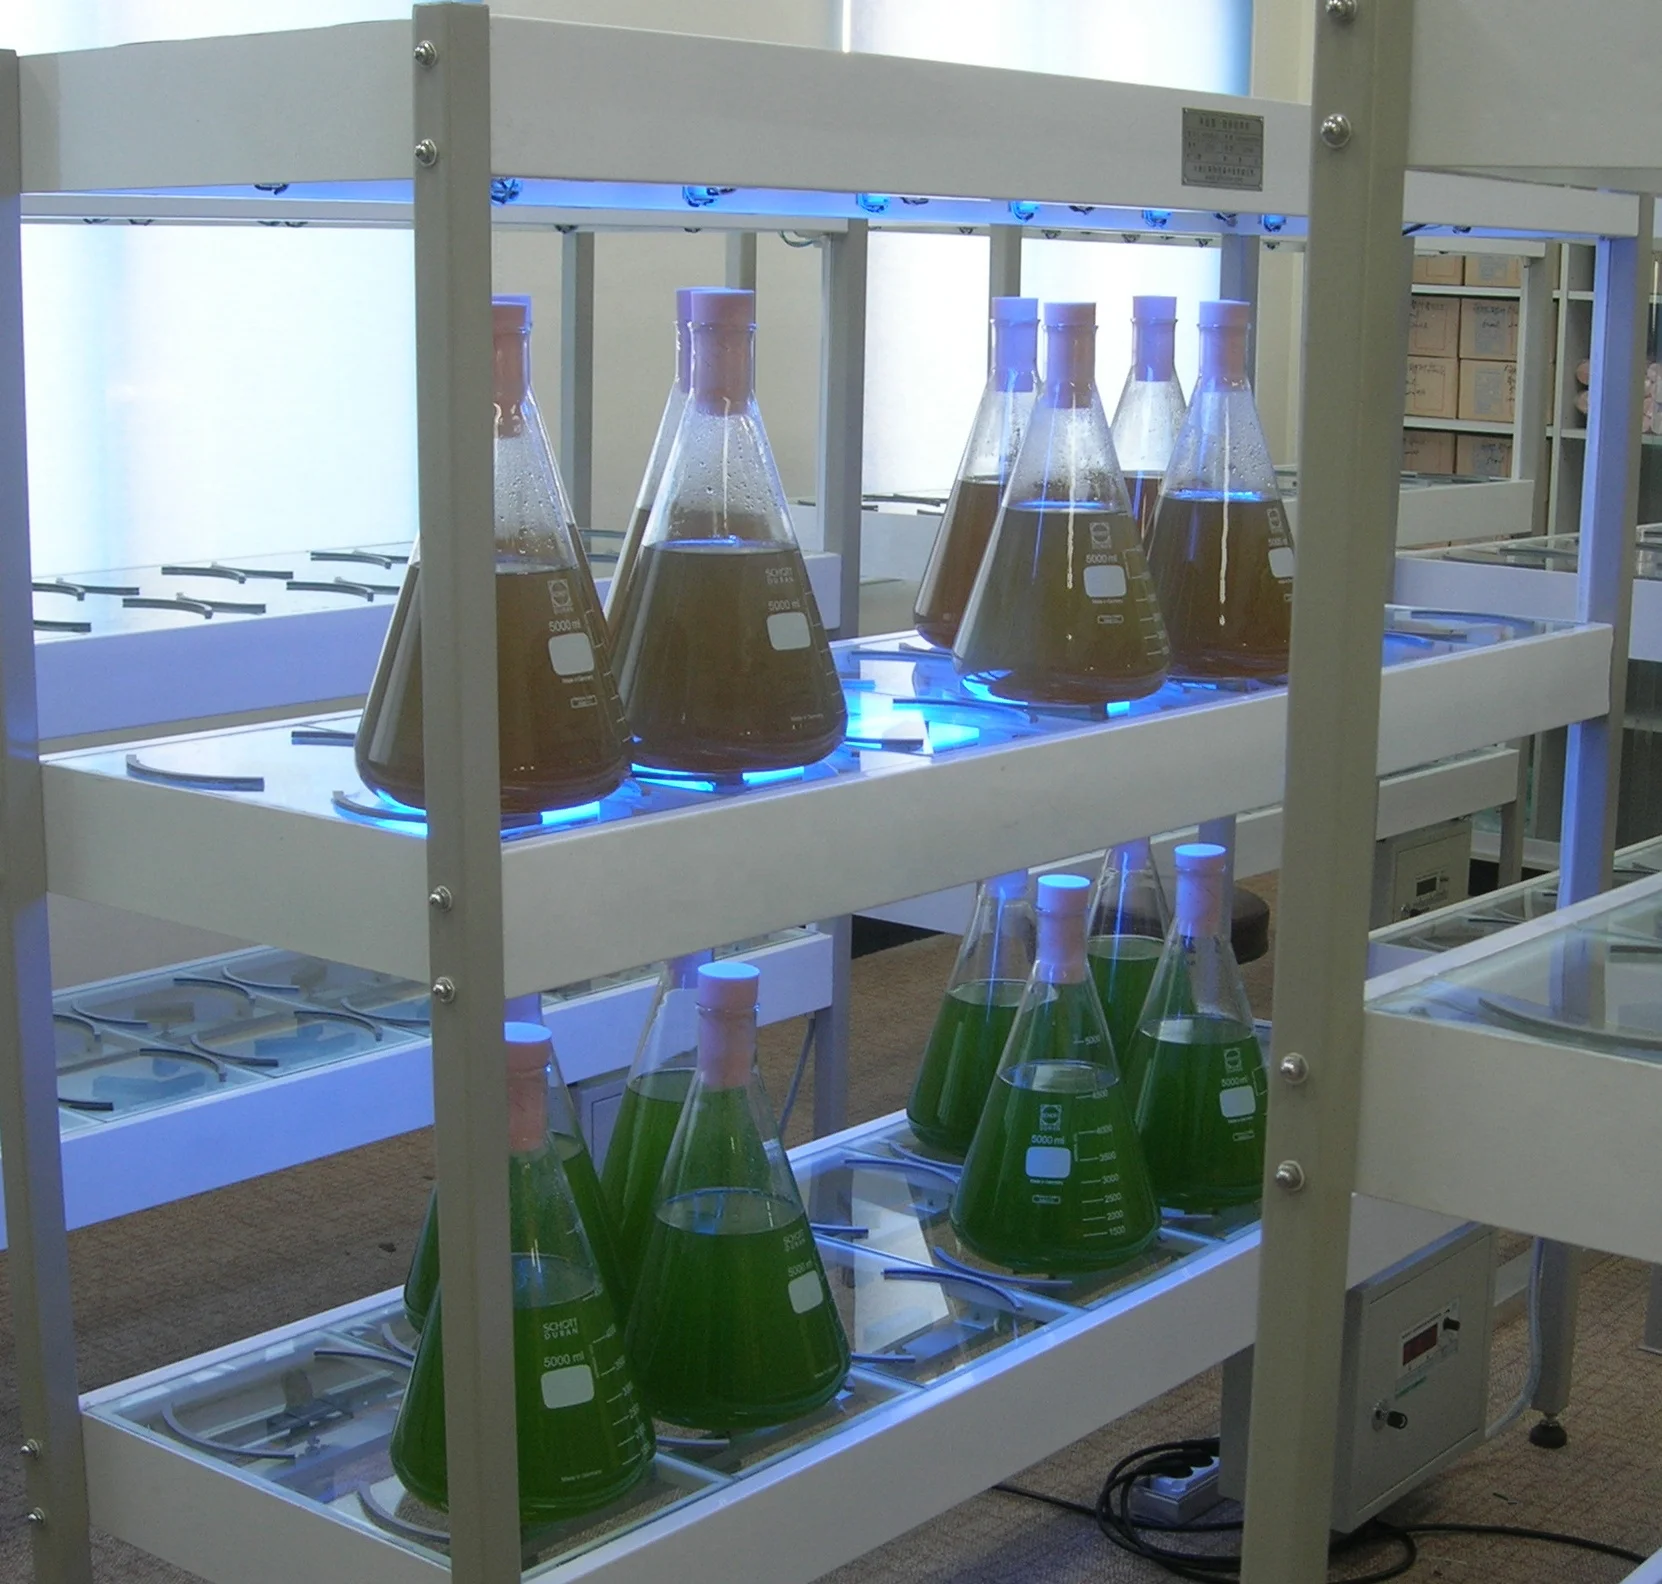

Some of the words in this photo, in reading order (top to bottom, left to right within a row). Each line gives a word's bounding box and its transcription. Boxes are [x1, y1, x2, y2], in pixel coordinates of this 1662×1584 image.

[1086, 554, 1107, 563] 5000
[768, 600, 790, 611] 5000
[791, 599, 801, 609] ml
[549, 620, 573, 632] 5000
[572, 619, 580, 629] ml
[1031, 1135, 1053, 1144] 5000
[1054, 1135, 1065, 1145] ml
[1099, 1151, 1117, 1162] 3500
[1102, 1174, 1120, 1184] 3000
[1105, 1193, 1122, 1203] 2500
[1107, 1210, 1124, 1220] 2000
[1109, 1226, 1126, 1236] 1500
[542, 1317, 578, 1332] SCHOTT
[544, 1328, 579, 1340] DURAN
[543, 1353, 571, 1368] 5000
[573, 1351, 585, 1364] ml
